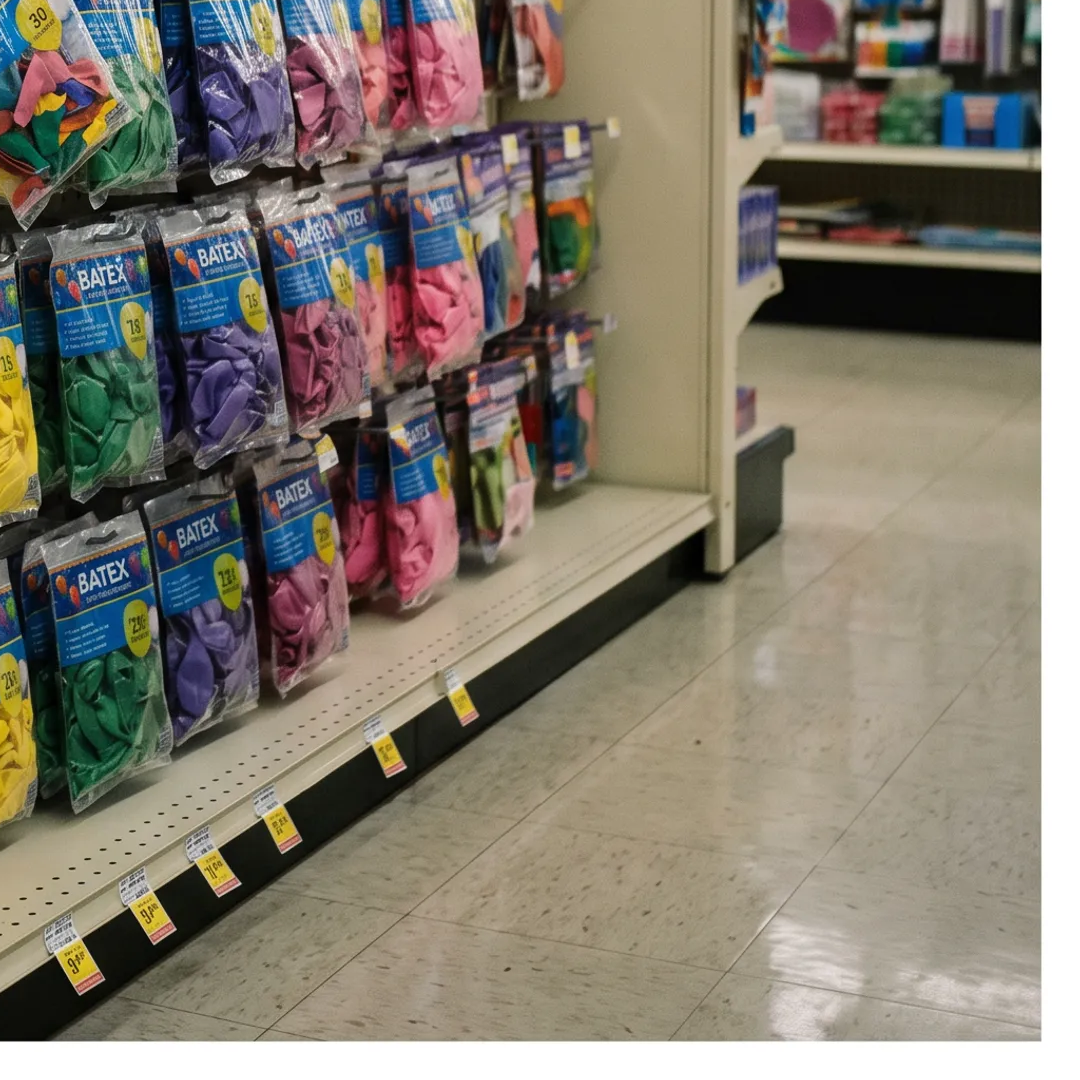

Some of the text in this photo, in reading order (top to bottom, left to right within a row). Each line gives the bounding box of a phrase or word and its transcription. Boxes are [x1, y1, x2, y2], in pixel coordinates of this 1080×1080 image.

[29, 7, 48, 29] 30
[197, 240, 245, 268] BATEX
[77, 263, 127, 291] BATEX
[276, 476, 313, 510] BATEX
[176, 512, 219, 549] BATEX
[78, 558, 129, 595] BATEX
